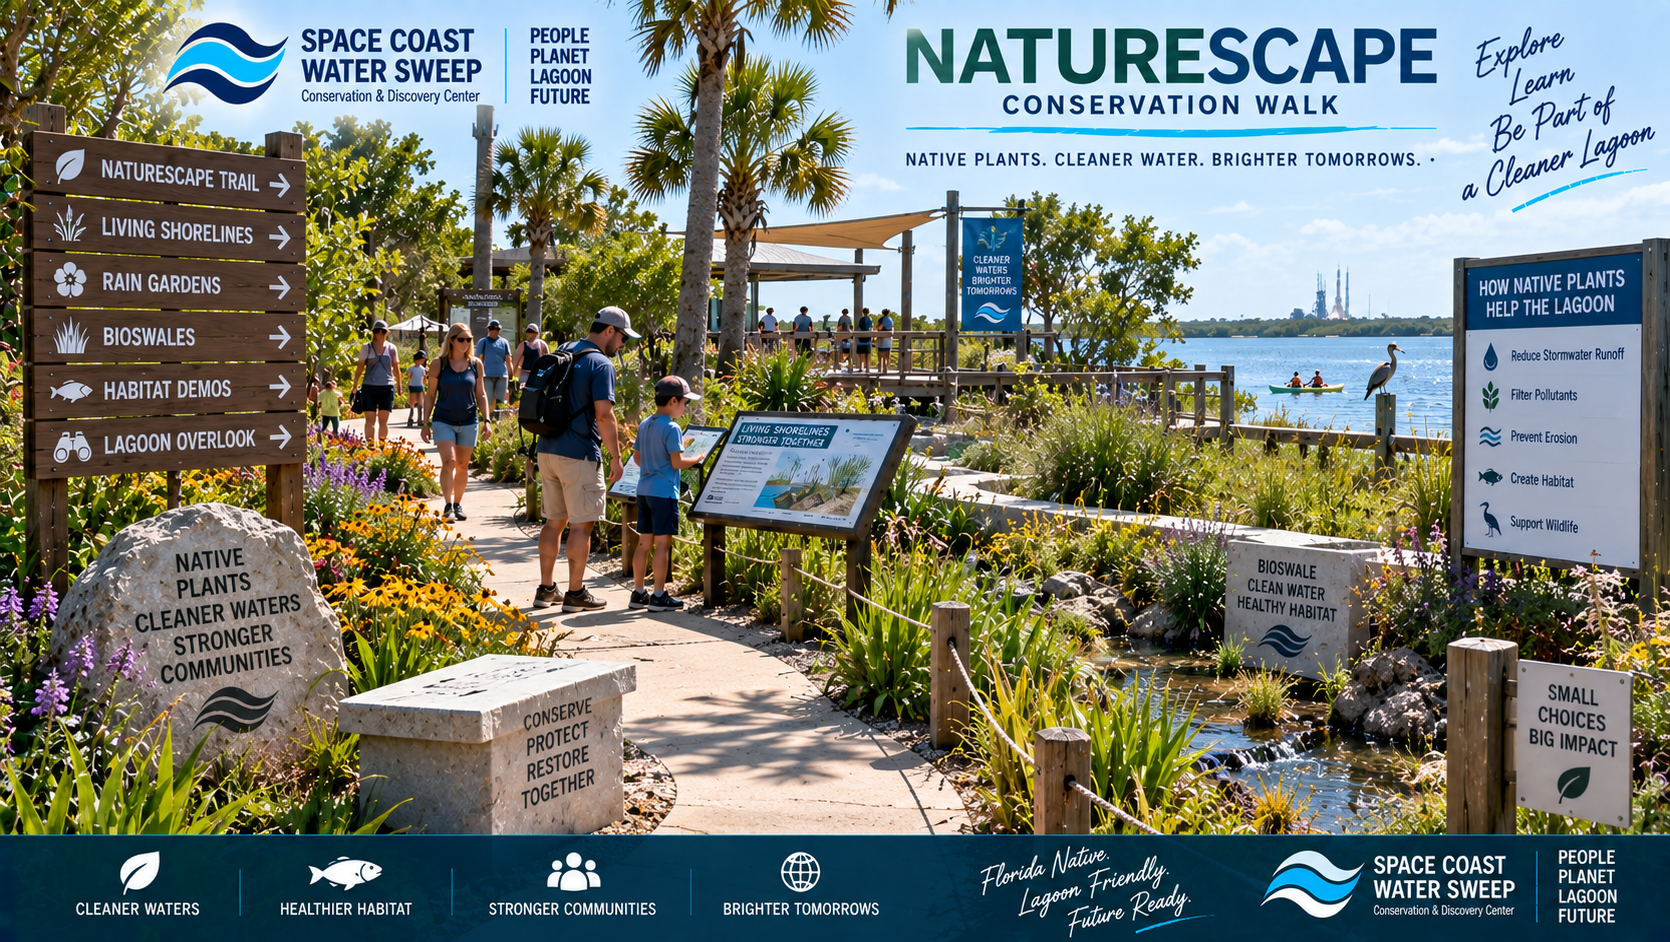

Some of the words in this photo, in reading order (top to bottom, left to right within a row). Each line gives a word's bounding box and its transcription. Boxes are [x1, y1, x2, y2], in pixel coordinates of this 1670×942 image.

[101, 158, 214, 188] NATURESCAPE
[219, 170, 260, 192] TRAIL
[101, 216, 155, 239] LIVING
[160, 221, 253, 245] SHORELINES
[973, 255, 1011, 264] CLEANER
[975, 265, 1008, 275] WATERS
[102, 271, 142, 292] RAIN
[148, 273, 221, 295] GARDENS
[966, 286, 1017, 295] TOMORROWS
[971, 276, 1012, 285] BRIGHTER
[1479, 278, 1510, 297] HOW
[1513, 274, 1562, 294] NATIVE
[1567, 269, 1625, 291] PLANTS
[1486, 300, 1519, 318] HELP
[1523, 298, 1550, 316] THE
[1554, 294, 1615, 315] LAGOON
[103, 326, 196, 347] BIOSWALES
[1511, 349, 1541, 362] Reduce
[1543, 348, 1592, 361] Stormwater
[1595, 347, 1625, 360] Runoff
[104, 380, 172, 400] HABITAT
[177, 379, 232, 399] DEMOS
[1511, 388, 1532, 401] Filter
[1534, 388, 1578, 401] Pollutants
[104, 432, 171, 455] LAGOON
[176, 429, 256, 451] OVERLOOK
[741, 424, 771, 434] LIVING
[773, 425, 830, 436] SHORELINES
[1510, 430, 1543, 443] Prevent
[1545, 431, 1578, 444] Erosion
[1510, 472, 1539, 486] Create
[1541, 474, 1575, 488] Habitat
[1510, 515, 1543, 531] Support
[1545, 518, 1579, 534] Wildlife
[175, 547, 245, 573] NATIVE
[1257, 558, 1317, 580] BIOSWALE
[176, 572, 252, 599] PLANTS
[1247, 578, 1284, 596] CLEAN
[1287, 583, 1326, 601] WATER
[135, 603, 226, 633] CLEANER
[229, 593, 301, 620] WATERS
[1237, 595, 1286, 615] HEALTHY
[1289, 602, 1337, 622] HABITAT
[173, 623, 274, 656] STRONGER
[160, 646, 293, 684] COMMUNITIES
[1548, 683, 1599, 706] SMALL
[523, 697, 593, 731] CONSERVE
[1538, 706, 1606, 732] CHOICES
[526, 720, 590, 756] PROTECT
[1529, 728, 1554, 748] BIG
[1560, 733, 1618, 758] IMPACT
[527, 745, 590, 782] RESTORE
[521, 768, 595, 809] TOGETHER
